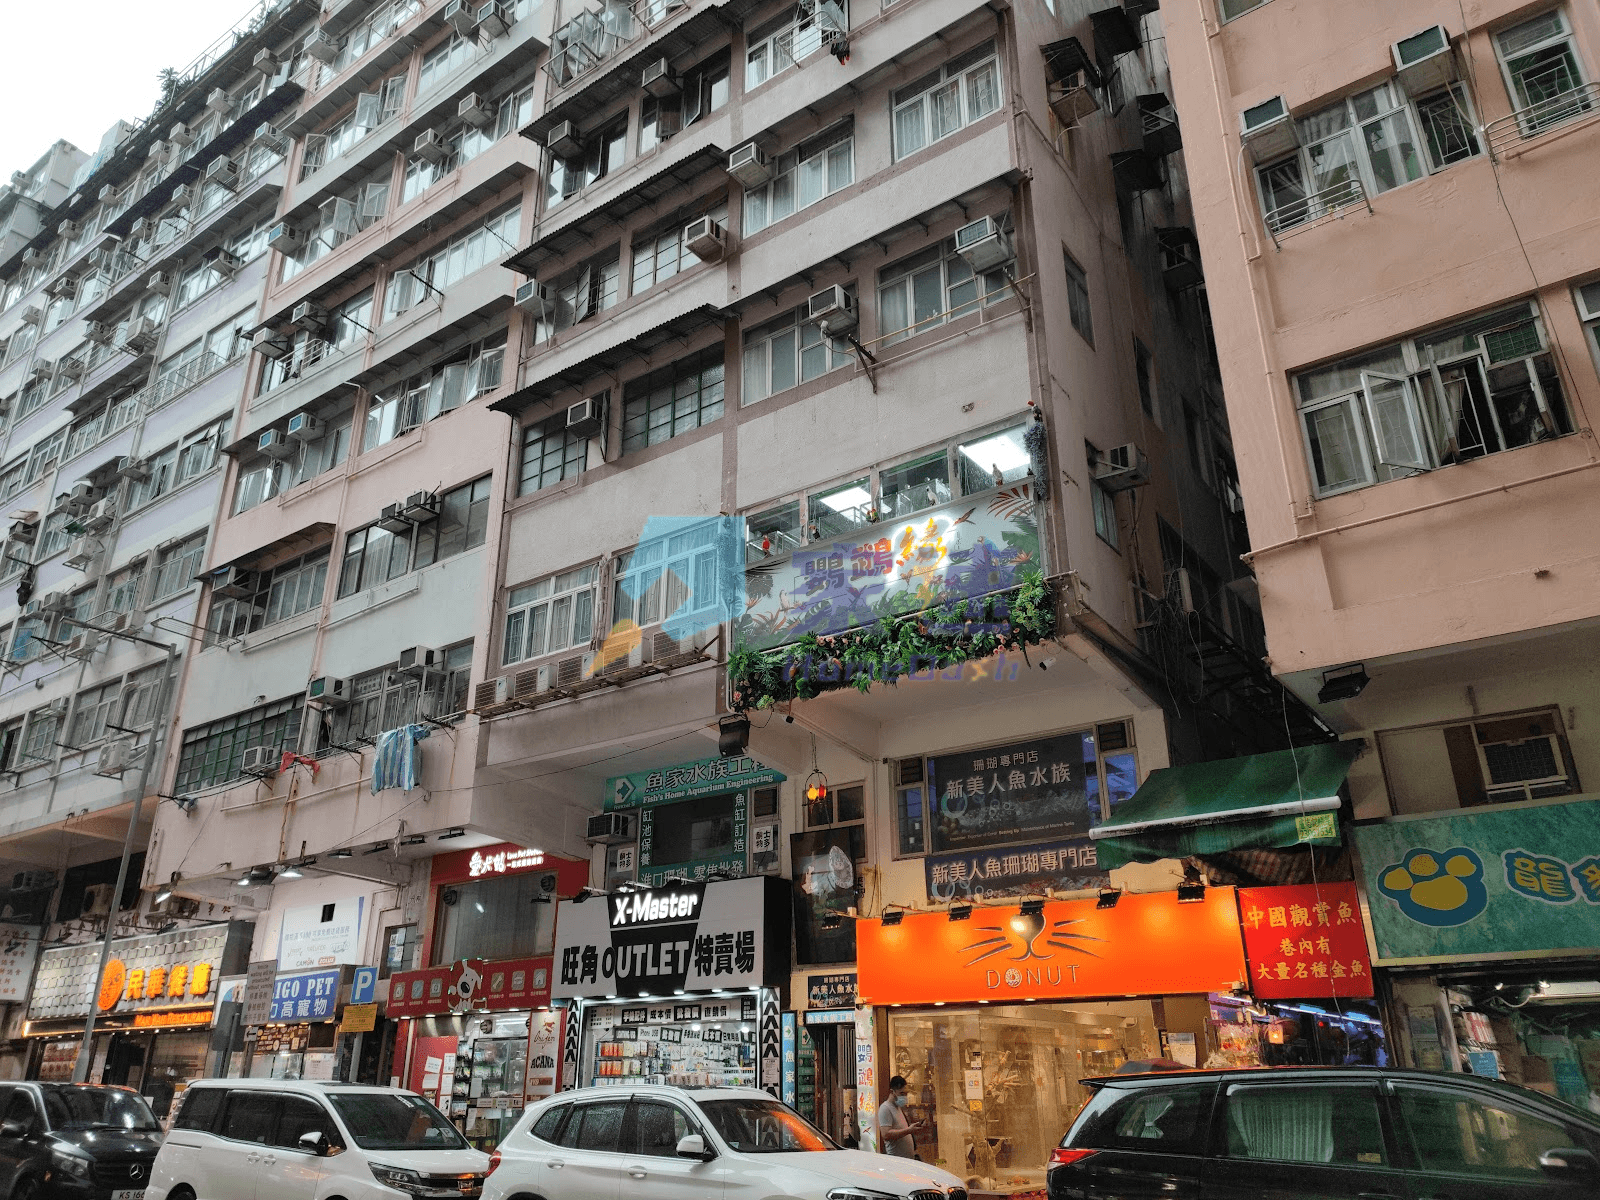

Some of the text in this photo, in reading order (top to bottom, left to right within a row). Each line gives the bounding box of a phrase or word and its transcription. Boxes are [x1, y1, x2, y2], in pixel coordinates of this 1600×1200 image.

[973, 750, 1038, 771] 珊瑚專門店
[643, 774, 773, 804] Fish's Home Aquarium Engineering
[947, 762, 1070, 799] 新美人魚水族
[733, 793, 745, 853] 魚缸訂造
[932, 846, 1097, 884] 新美人魚珊瑚專門店
[613, 893, 697, 925] X-Master
[1247, 902, 1356, 930] 中國觀賞魚
[561, 931, 755, 985] 旺角 OUTLET 特賣場
[1280, 936, 1330, 956] 巷內有
[986, 964, 1080, 989] DONUT
[1257, 960, 1366, 980] 大量名種金魚
[272, 977, 334, 999] IGO PET
[355, 971, 373, 1000] P
[531, 1055, 554, 1068] ACANA
[119, 1191, 130, 1199] KS
